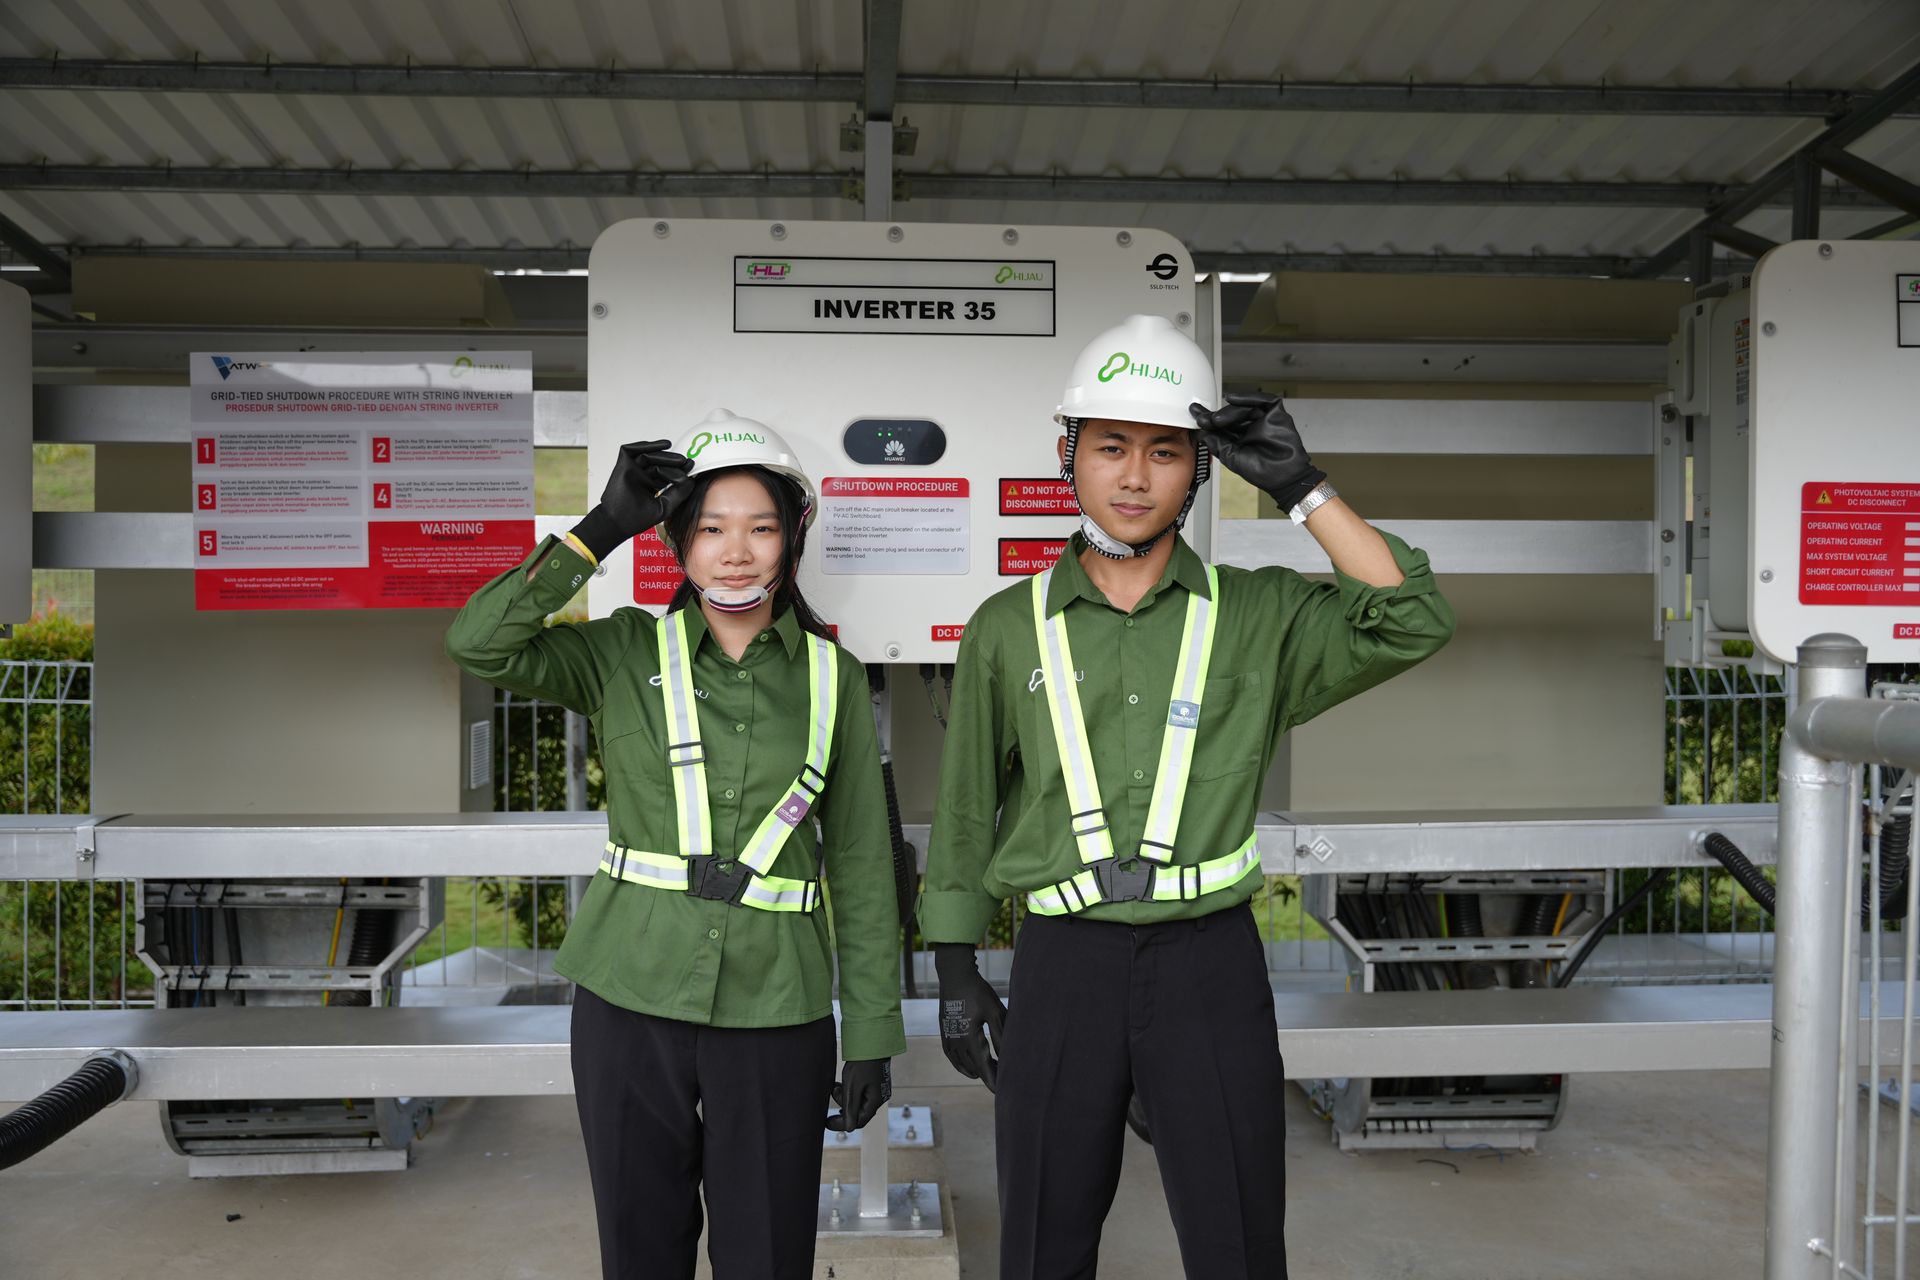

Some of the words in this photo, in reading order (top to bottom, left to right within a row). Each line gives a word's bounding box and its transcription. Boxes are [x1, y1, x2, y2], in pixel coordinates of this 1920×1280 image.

[1013, 272, 1043, 281] HIJAU
[814, 300, 955, 320] INVERTER
[964, 301, 996, 320] 35
[1130, 362, 1182, 386] HIJAU
[211, 392, 263, 400] GRID-TIED
[267, 392, 325, 400] SHUTDOWN
[329, 392, 391, 400] PROCEDURE
[394, 392, 419, 400] WITH
[423, 392, 459, 400] STRING
[463, 391, 512, 400] INVERTER
[226, 404, 274, 412] PROSEDUR
[277, 404, 328, 412] SHUTDOWN
[331, 404, 376, 412] GRID-TIED
[380, 403, 417, 412] DENGAN
[420, 403, 452, 411] STRING
[455, 403, 499, 411] INVERTER
[715, 433, 765, 444] HIJAU
[203, 444, 209, 459] 1
[376, 443, 387, 458] 2
[832, 482, 894, 491] SHUTDOWN
[896, 482, 958, 492] PROCEDURE
[1022, 486, 1034, 494] DO
[1037, 486, 1055, 494] NOT
[202, 490, 212, 504] 3
[377, 489, 387, 503] 4
[1006, 500, 1061, 508] DISCONNECT
[420, 523, 484, 534] WARNING
[203, 536, 213, 551] 5
[937, 629, 952, 637] DC
[1900, 627, 1912, 636] DC
